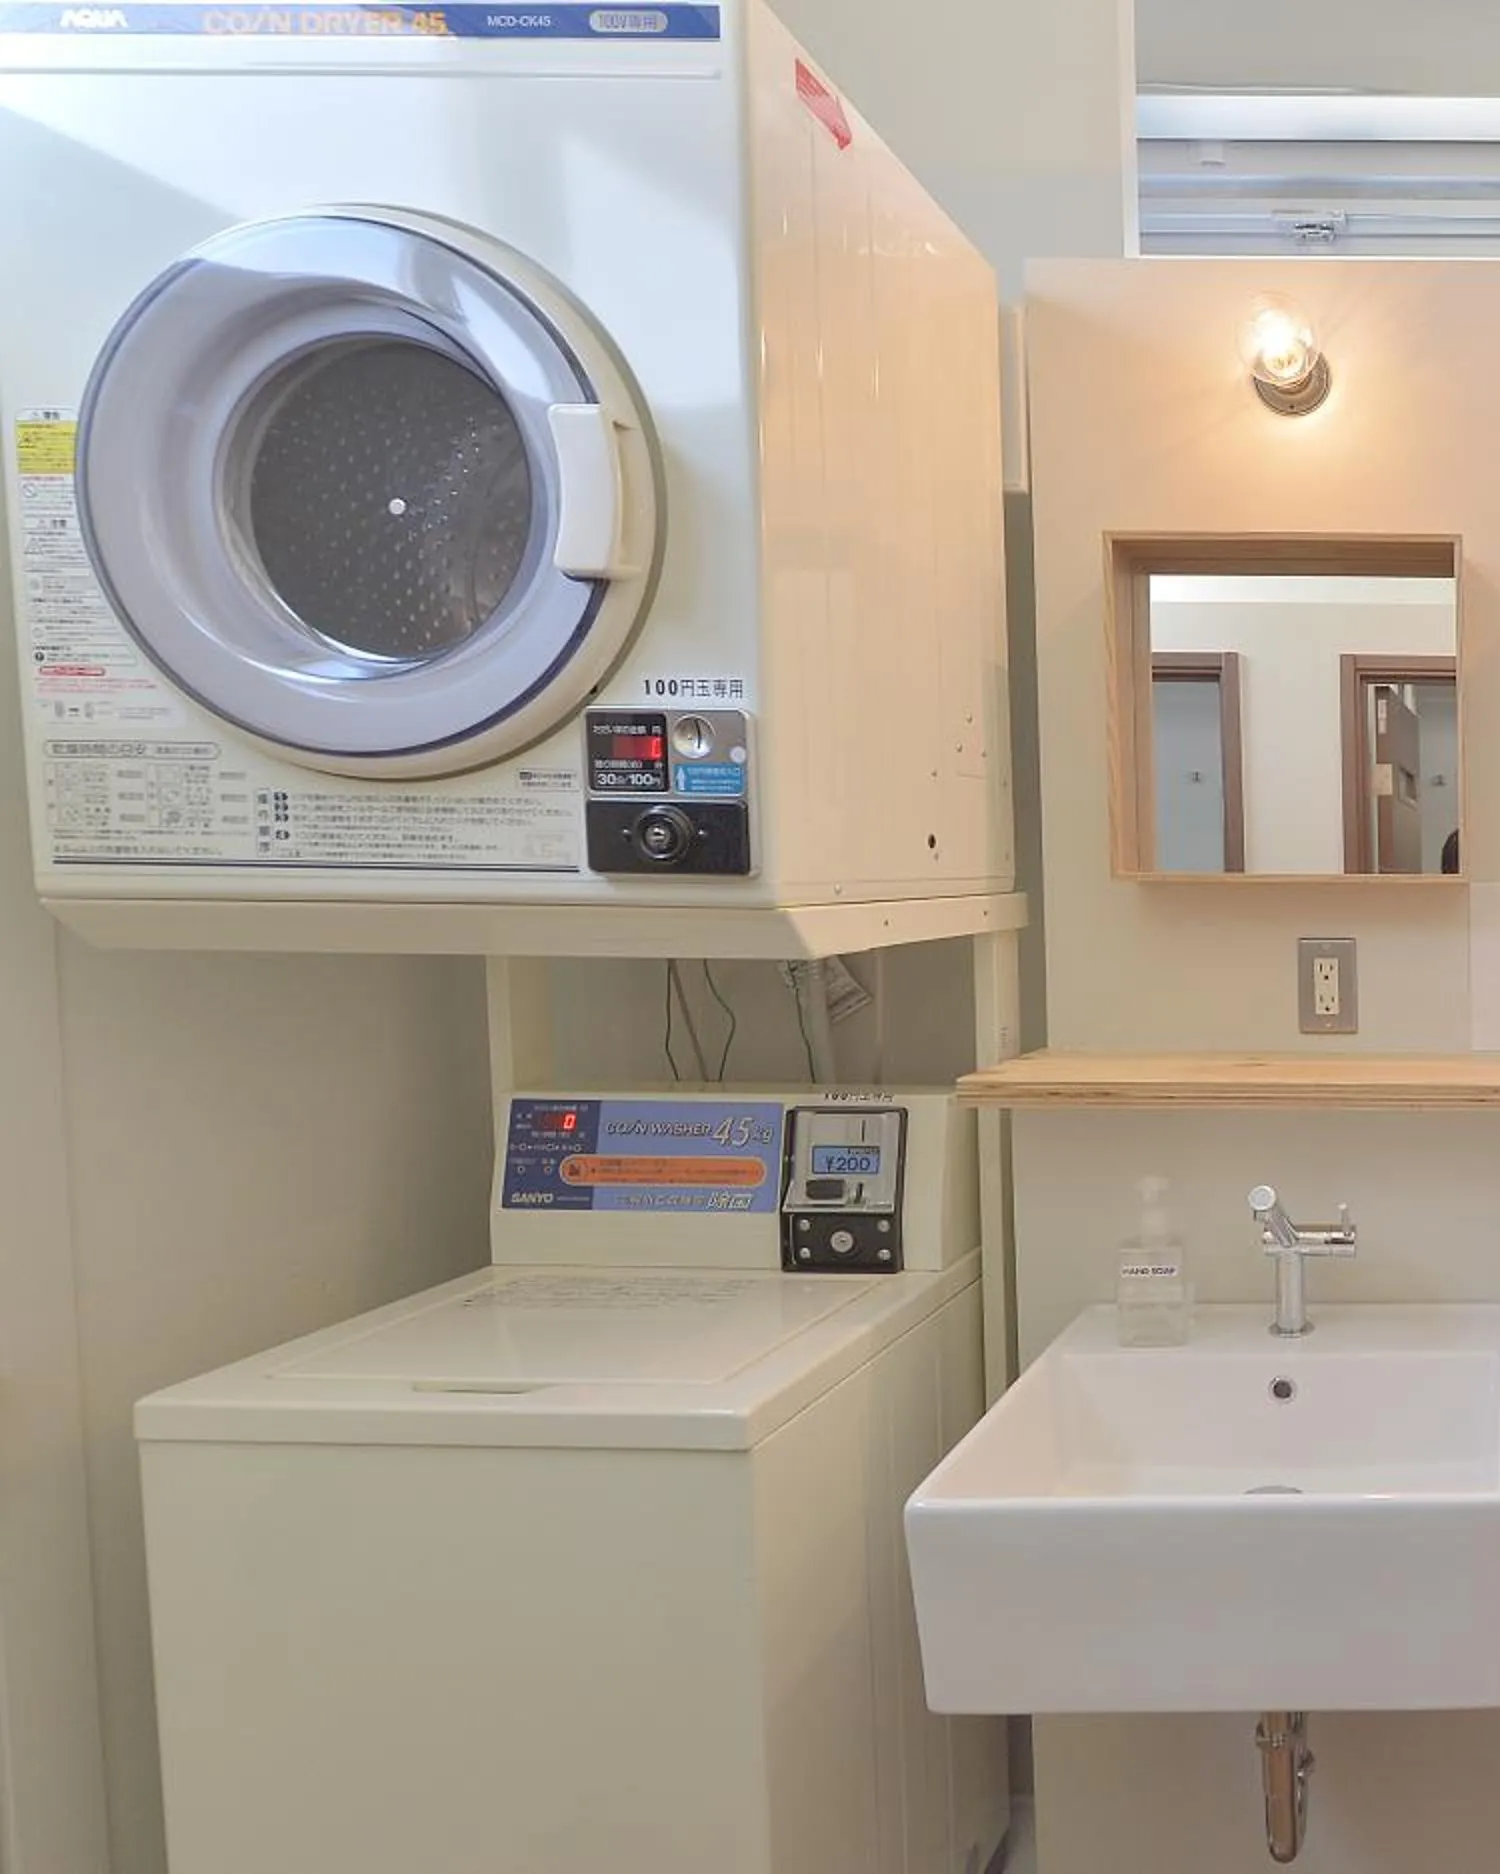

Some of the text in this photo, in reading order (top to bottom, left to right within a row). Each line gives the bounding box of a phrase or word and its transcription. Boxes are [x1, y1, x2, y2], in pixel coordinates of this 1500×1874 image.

[60, 9, 128, 28] AQUA
[299, 11, 403, 35] DRYER
[410, 11, 448, 35] 45
[643, 679, 744, 698] 100円玉専用
[563, 1113, 577, 1129] 0
[651, 1122, 711, 1137] WASHER
[826, 1155, 871, 1173] ¥200
[511, 1192, 554, 1204] SANYO
[1151, 1266, 1176, 1275] SOAP
